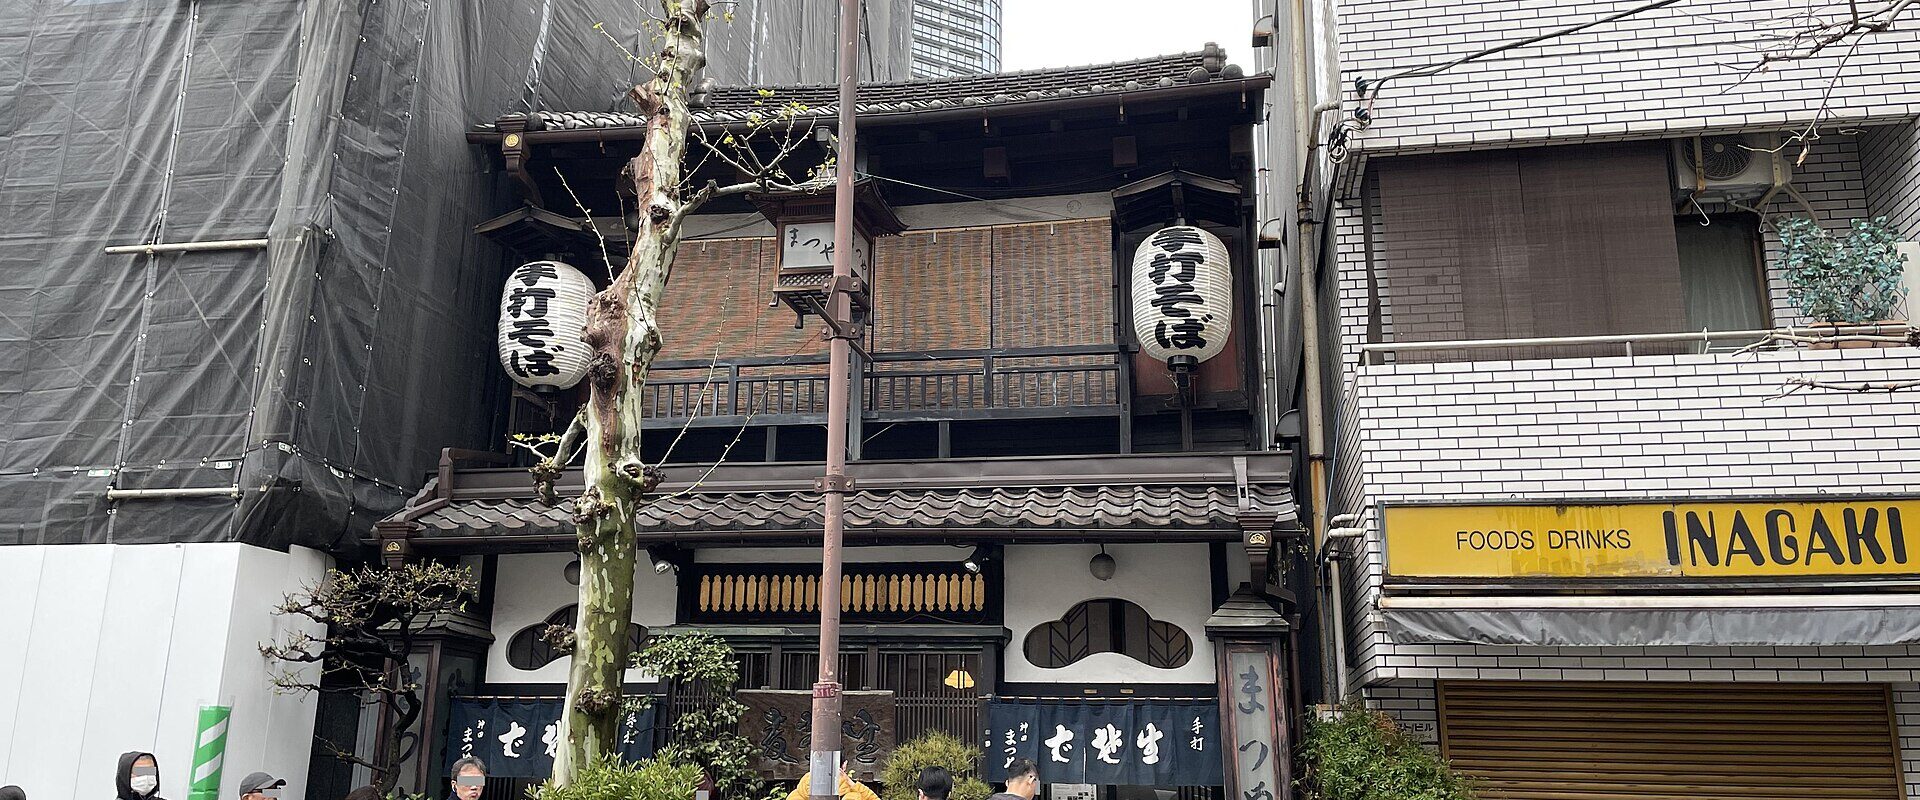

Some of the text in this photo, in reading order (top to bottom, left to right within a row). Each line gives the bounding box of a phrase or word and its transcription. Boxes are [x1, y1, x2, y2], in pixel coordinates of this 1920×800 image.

[1148, 227, 1214, 350] 手打そば
[507, 262, 565, 379] 手打そば
[1456, 529, 1632, 550] FOODS DRINKS
[1662, 506, 1908, 566] INAGAKI
[1190, 716, 1204, 752] 手打
